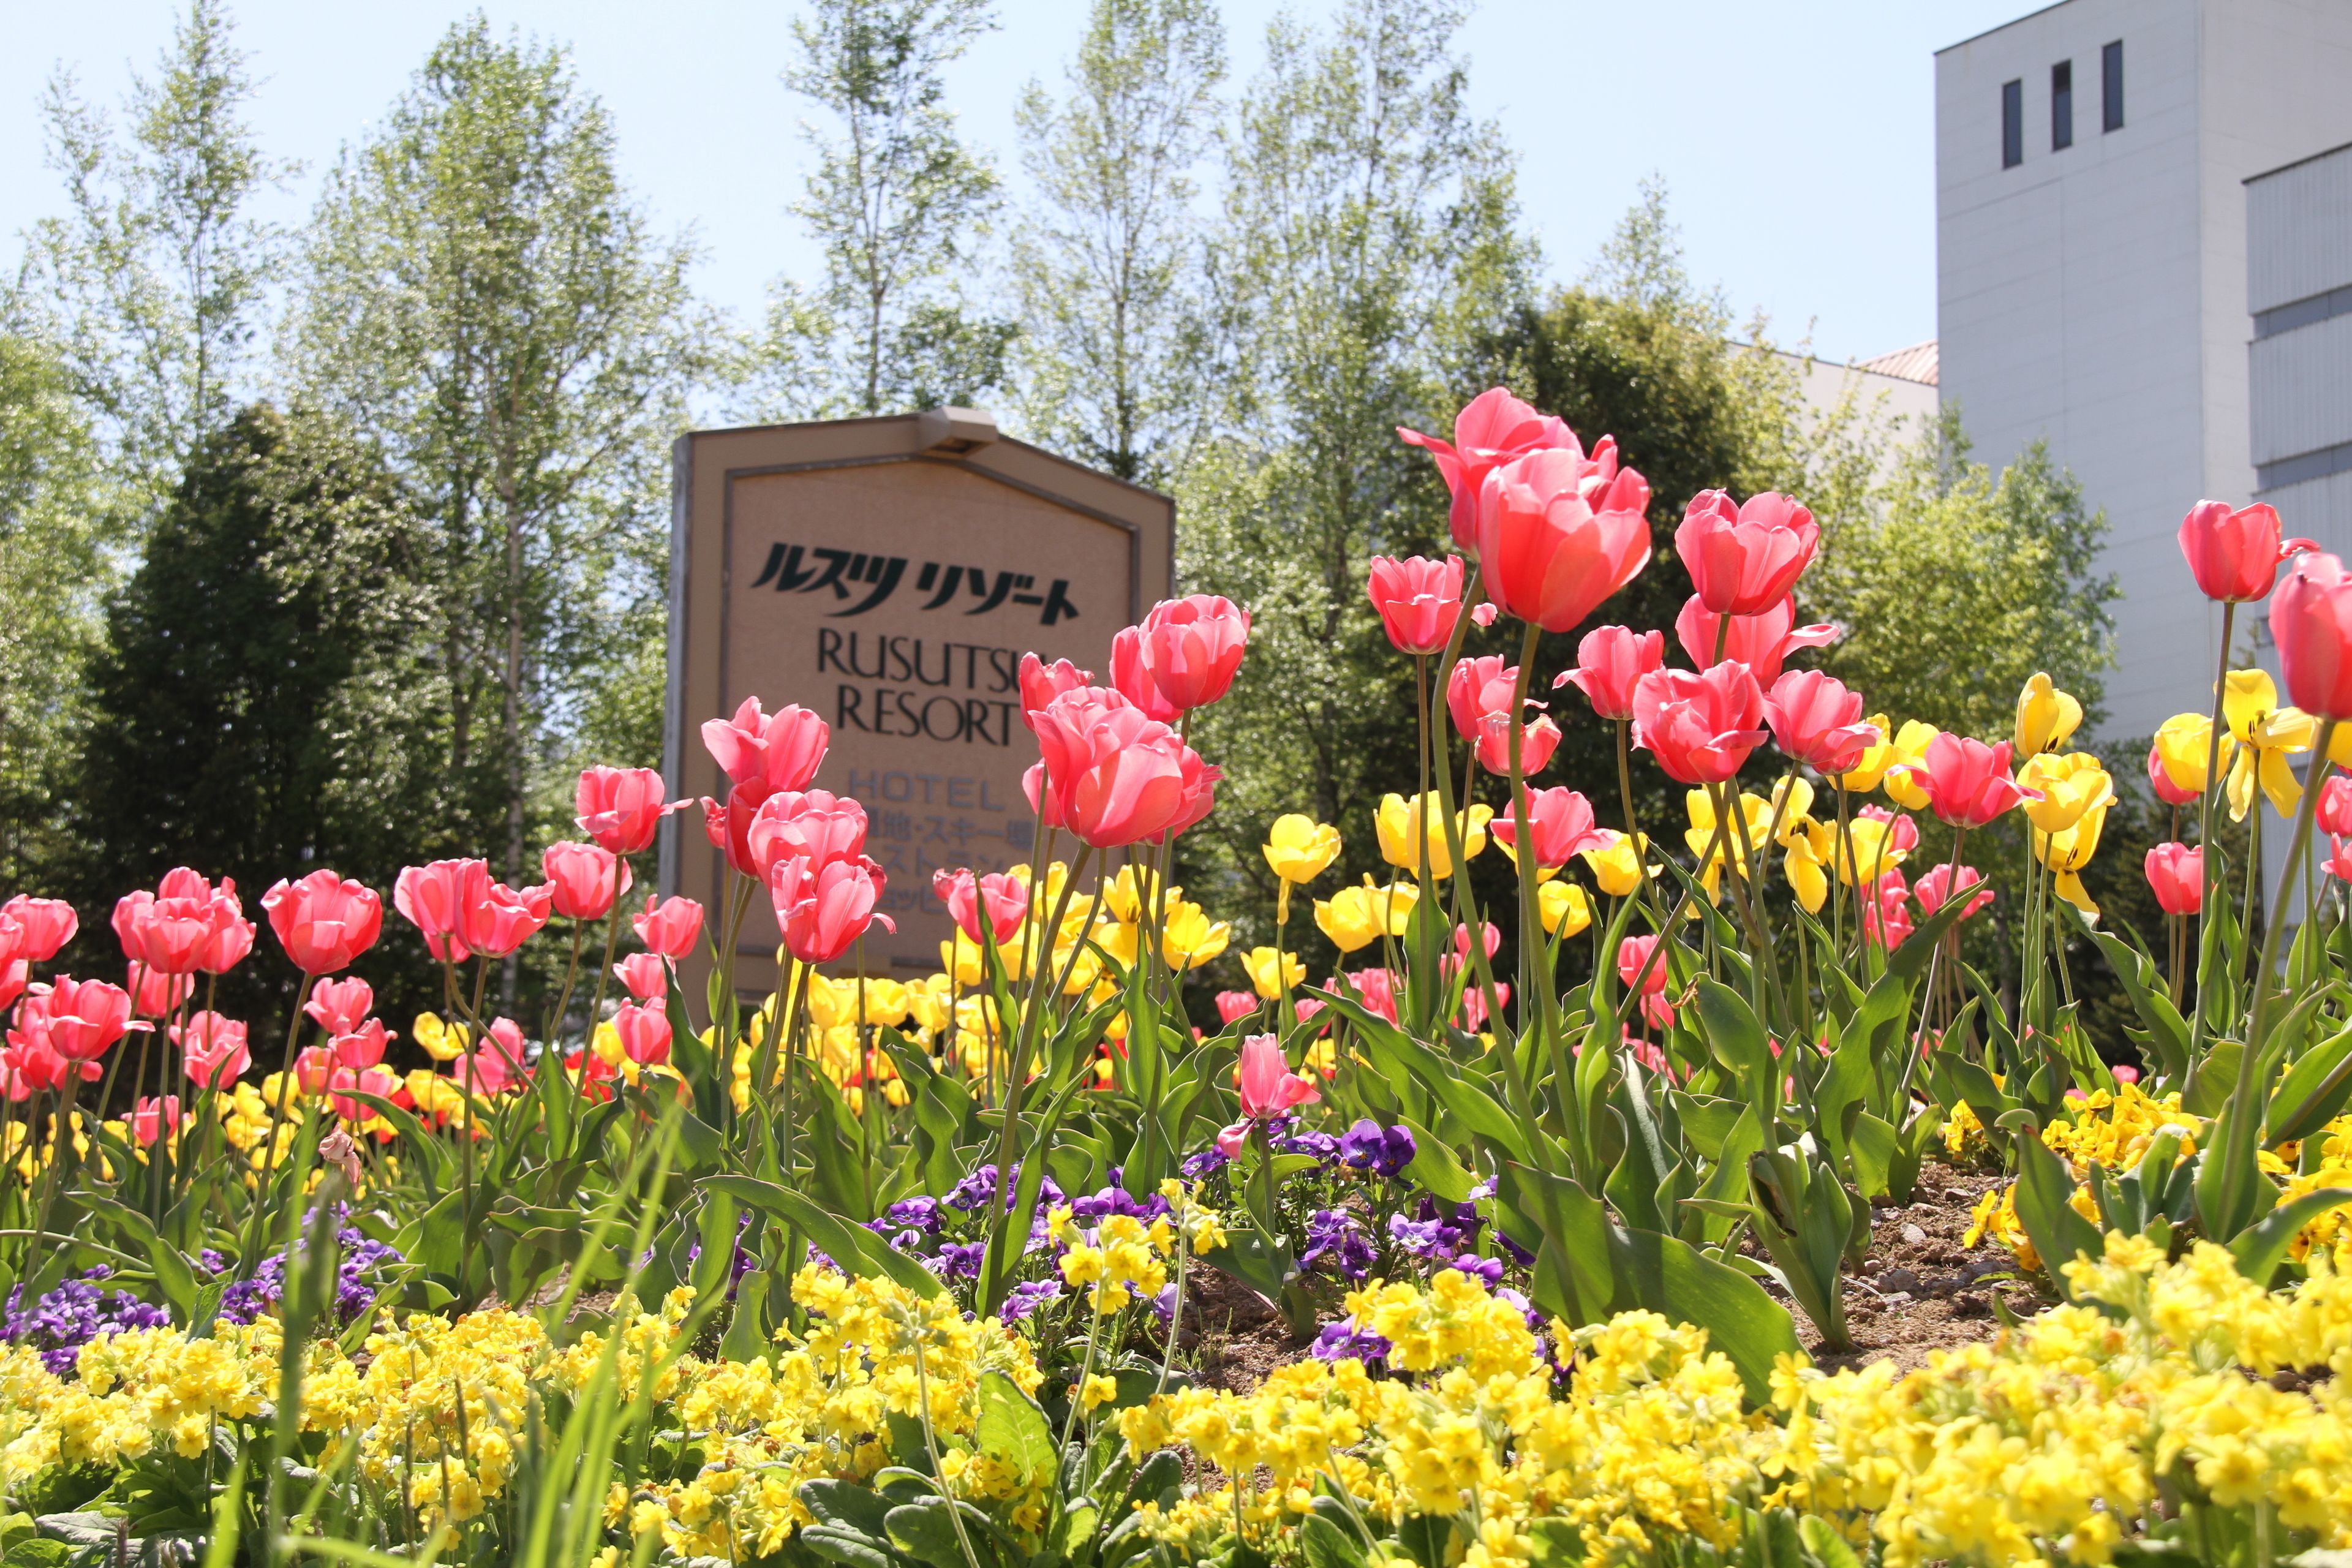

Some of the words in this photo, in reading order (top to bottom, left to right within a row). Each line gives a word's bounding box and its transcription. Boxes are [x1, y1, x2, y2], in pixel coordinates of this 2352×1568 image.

[750, 542, 908, 617] ルスツ
[916, 562, 1079, 626] リゾート
[837, 684, 1020, 747] RESORT
[849, 768, 1005, 812] HOTEL
